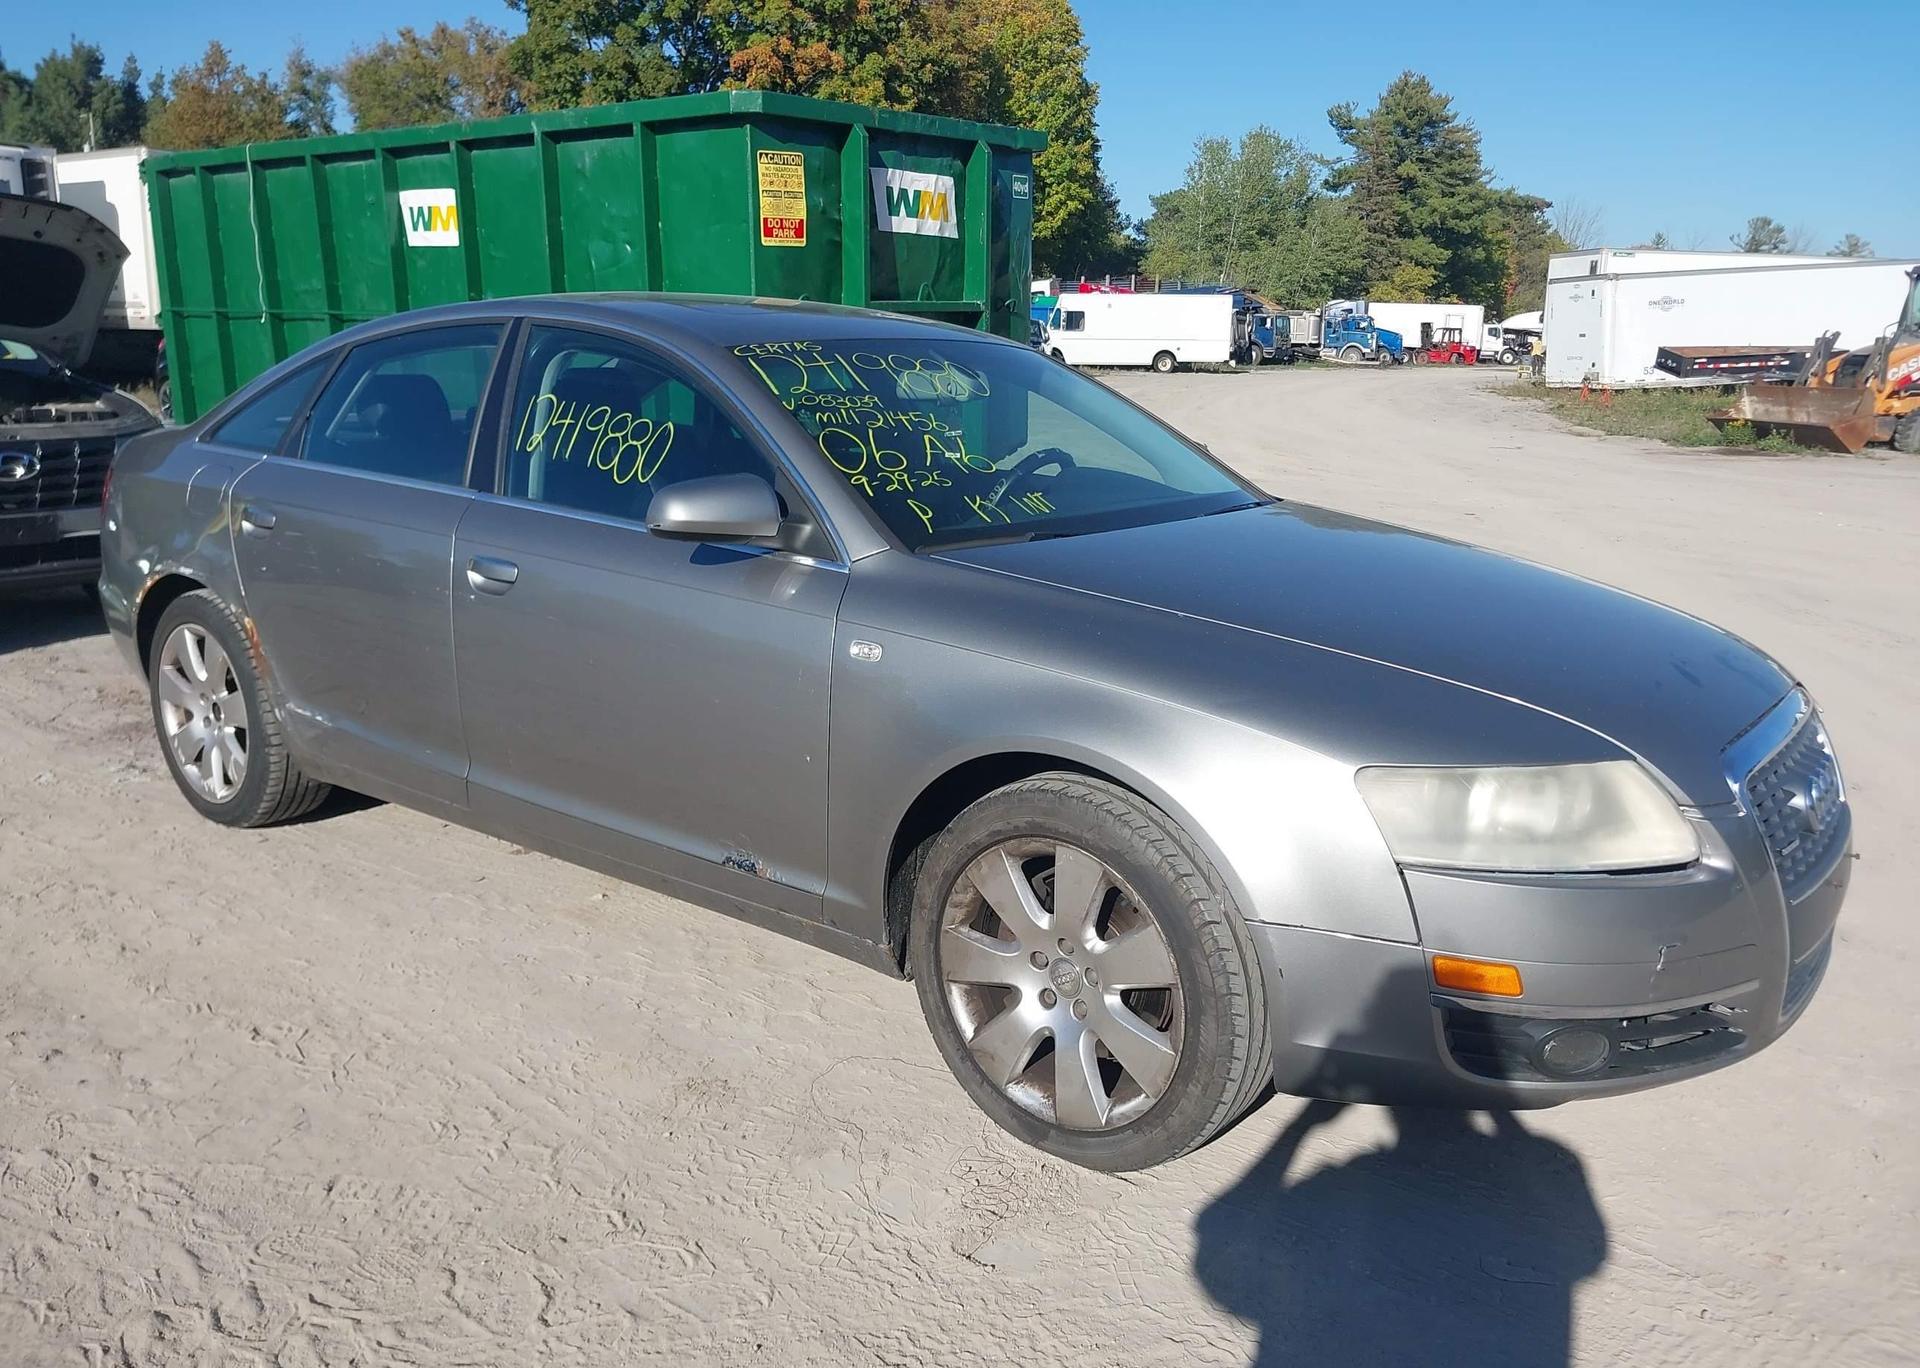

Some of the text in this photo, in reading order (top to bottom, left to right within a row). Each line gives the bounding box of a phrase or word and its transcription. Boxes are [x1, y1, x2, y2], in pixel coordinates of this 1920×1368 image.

[767, 153, 802, 165] CAUTION
[885, 186, 949, 223] WM
[408, 206, 459, 232] WM
[767, 218, 800, 229] DO NOT
[772, 228, 796, 238] PARK
[747, 352, 991, 398] 12419880
[1887, 356, 1920, 380] CAS
[515, 393, 675, 484] 12419880
